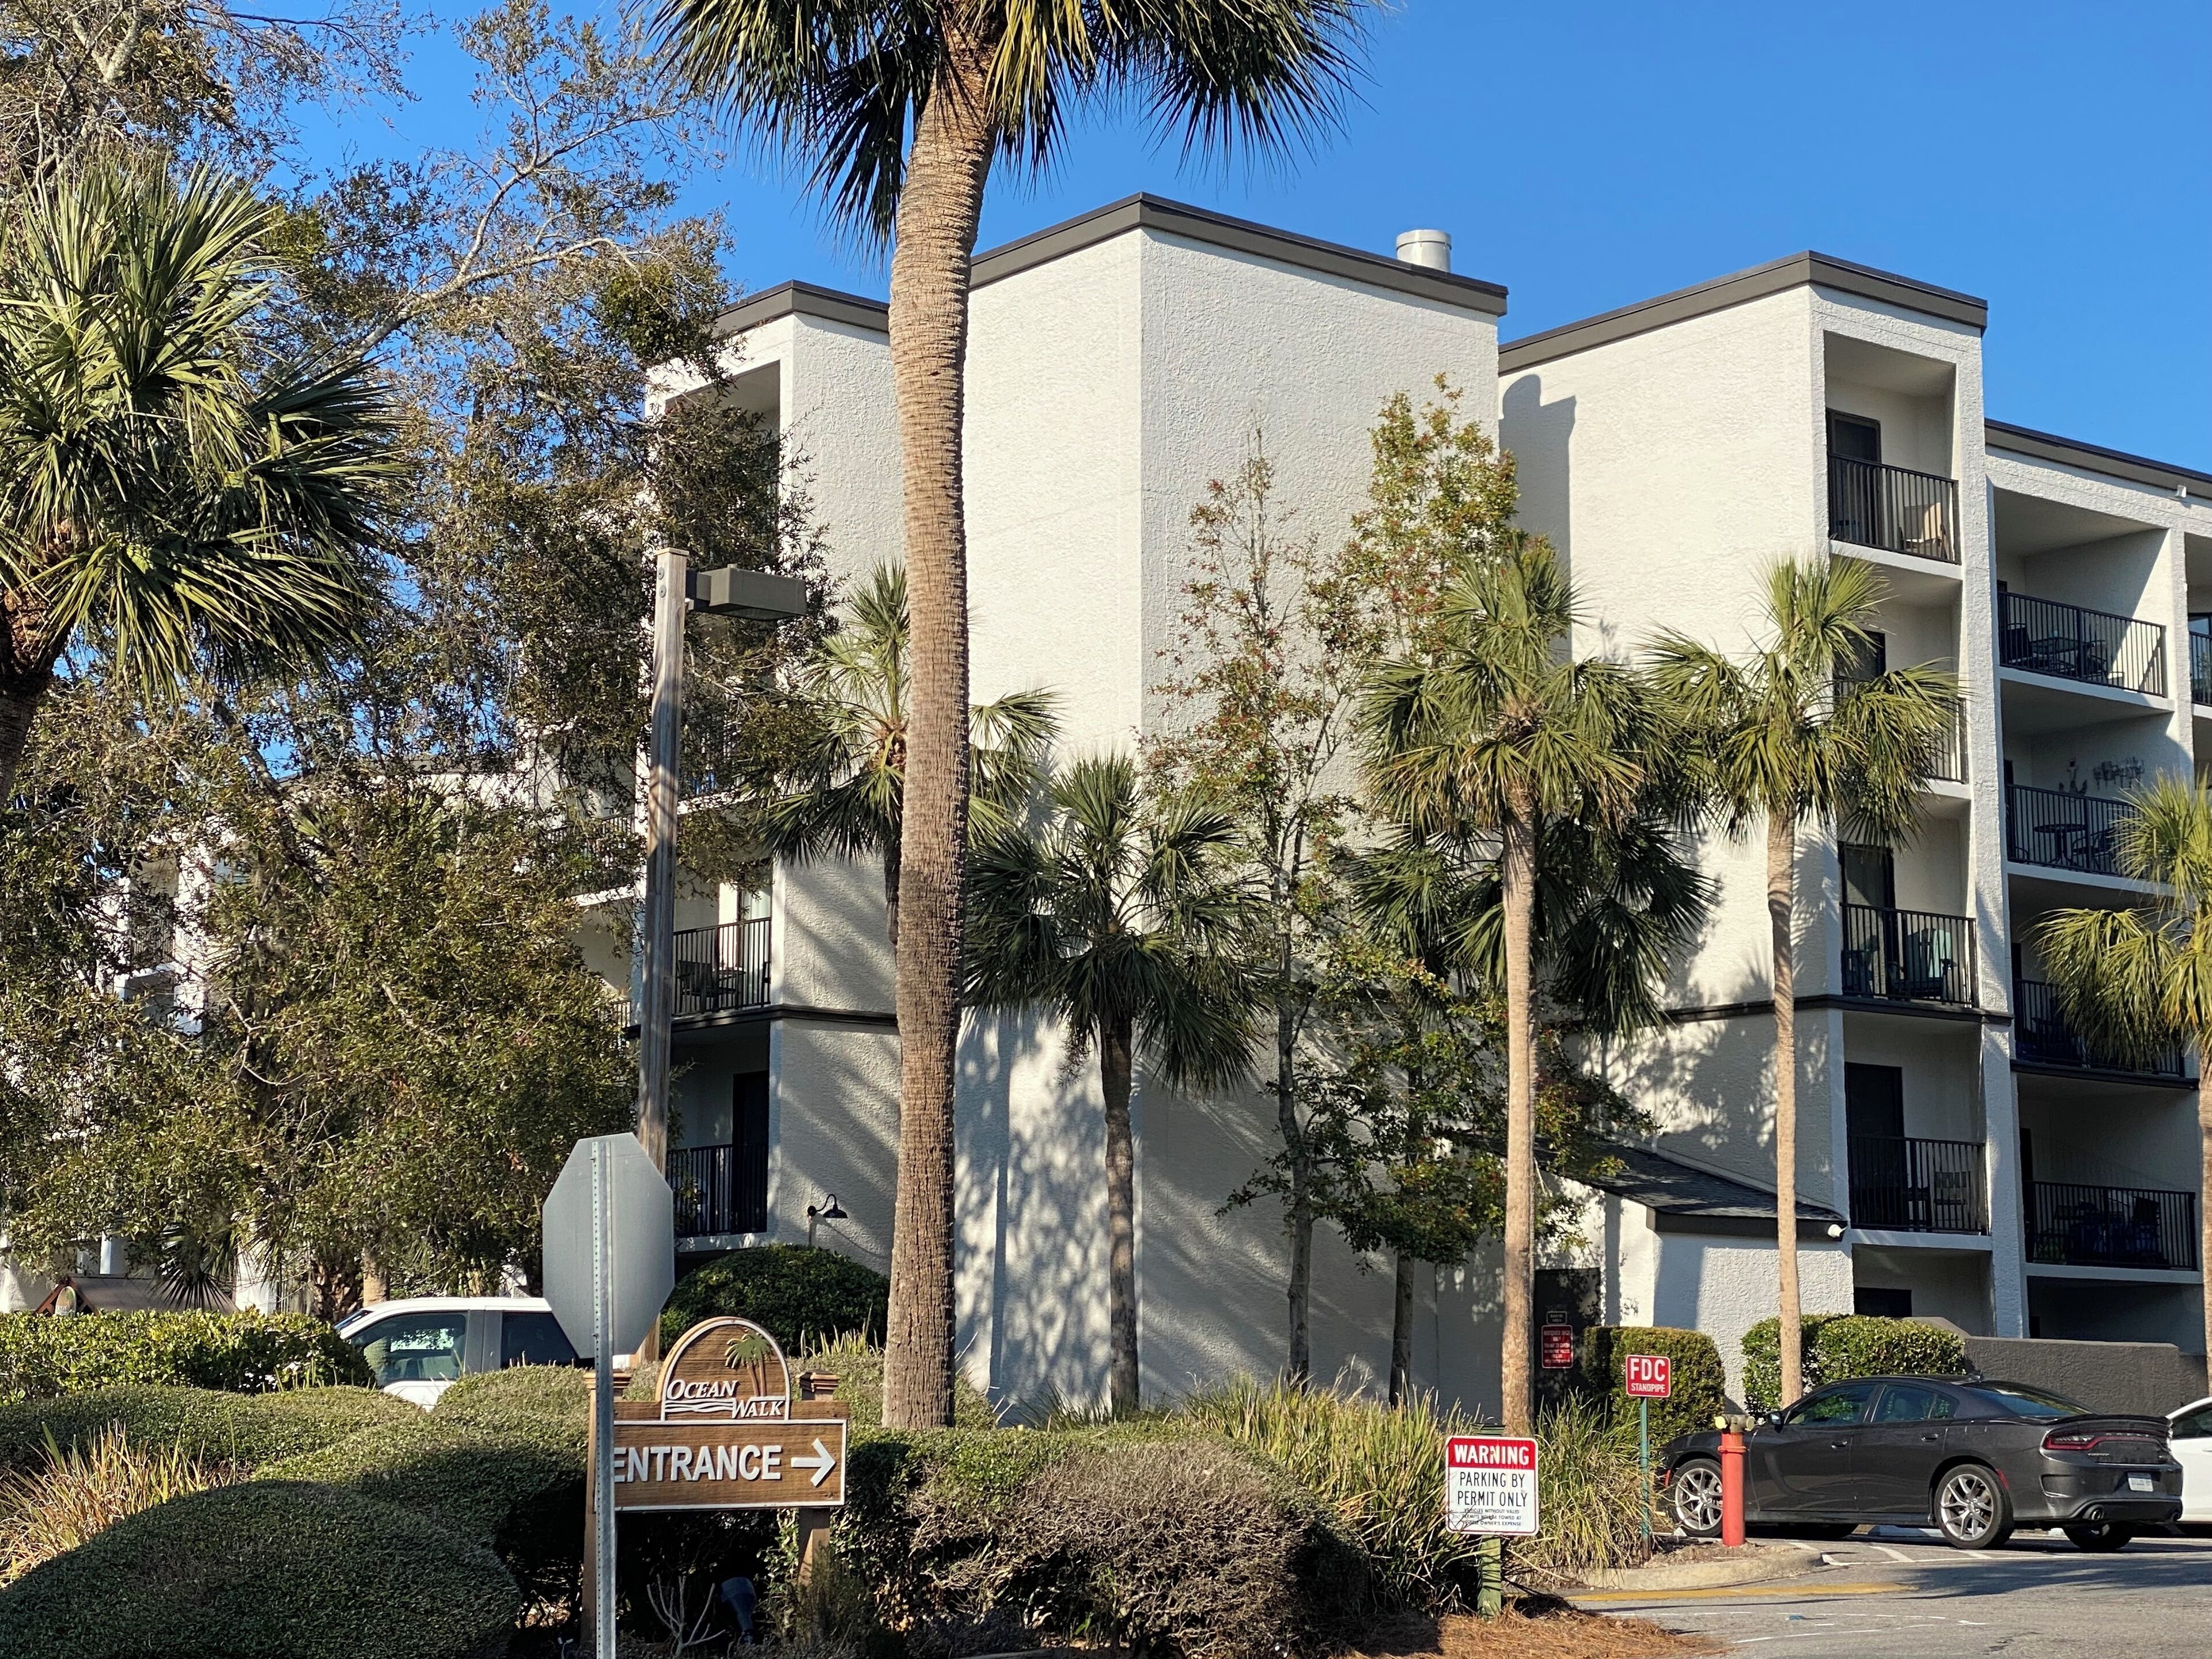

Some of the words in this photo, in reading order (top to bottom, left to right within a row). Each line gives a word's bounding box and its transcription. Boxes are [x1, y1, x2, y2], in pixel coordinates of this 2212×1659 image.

[1630, 1358, 1665, 1382] FDC
[666, 1379, 738, 1400] OCEAN
[1631, 1382, 1665, 1393] STANDPIPE
[731, 1399, 783, 1419] WALK
[613, 1445, 782, 1483] ENTRANCE
[1454, 1444, 1529, 1465] WARNING
[1460, 1472, 1506, 1487] PARKING
[1512, 1473, 1525, 1488] BY
[1457, 1490, 1495, 1506] PERMIT
[1499, 1491, 1527, 1507] ONLY
